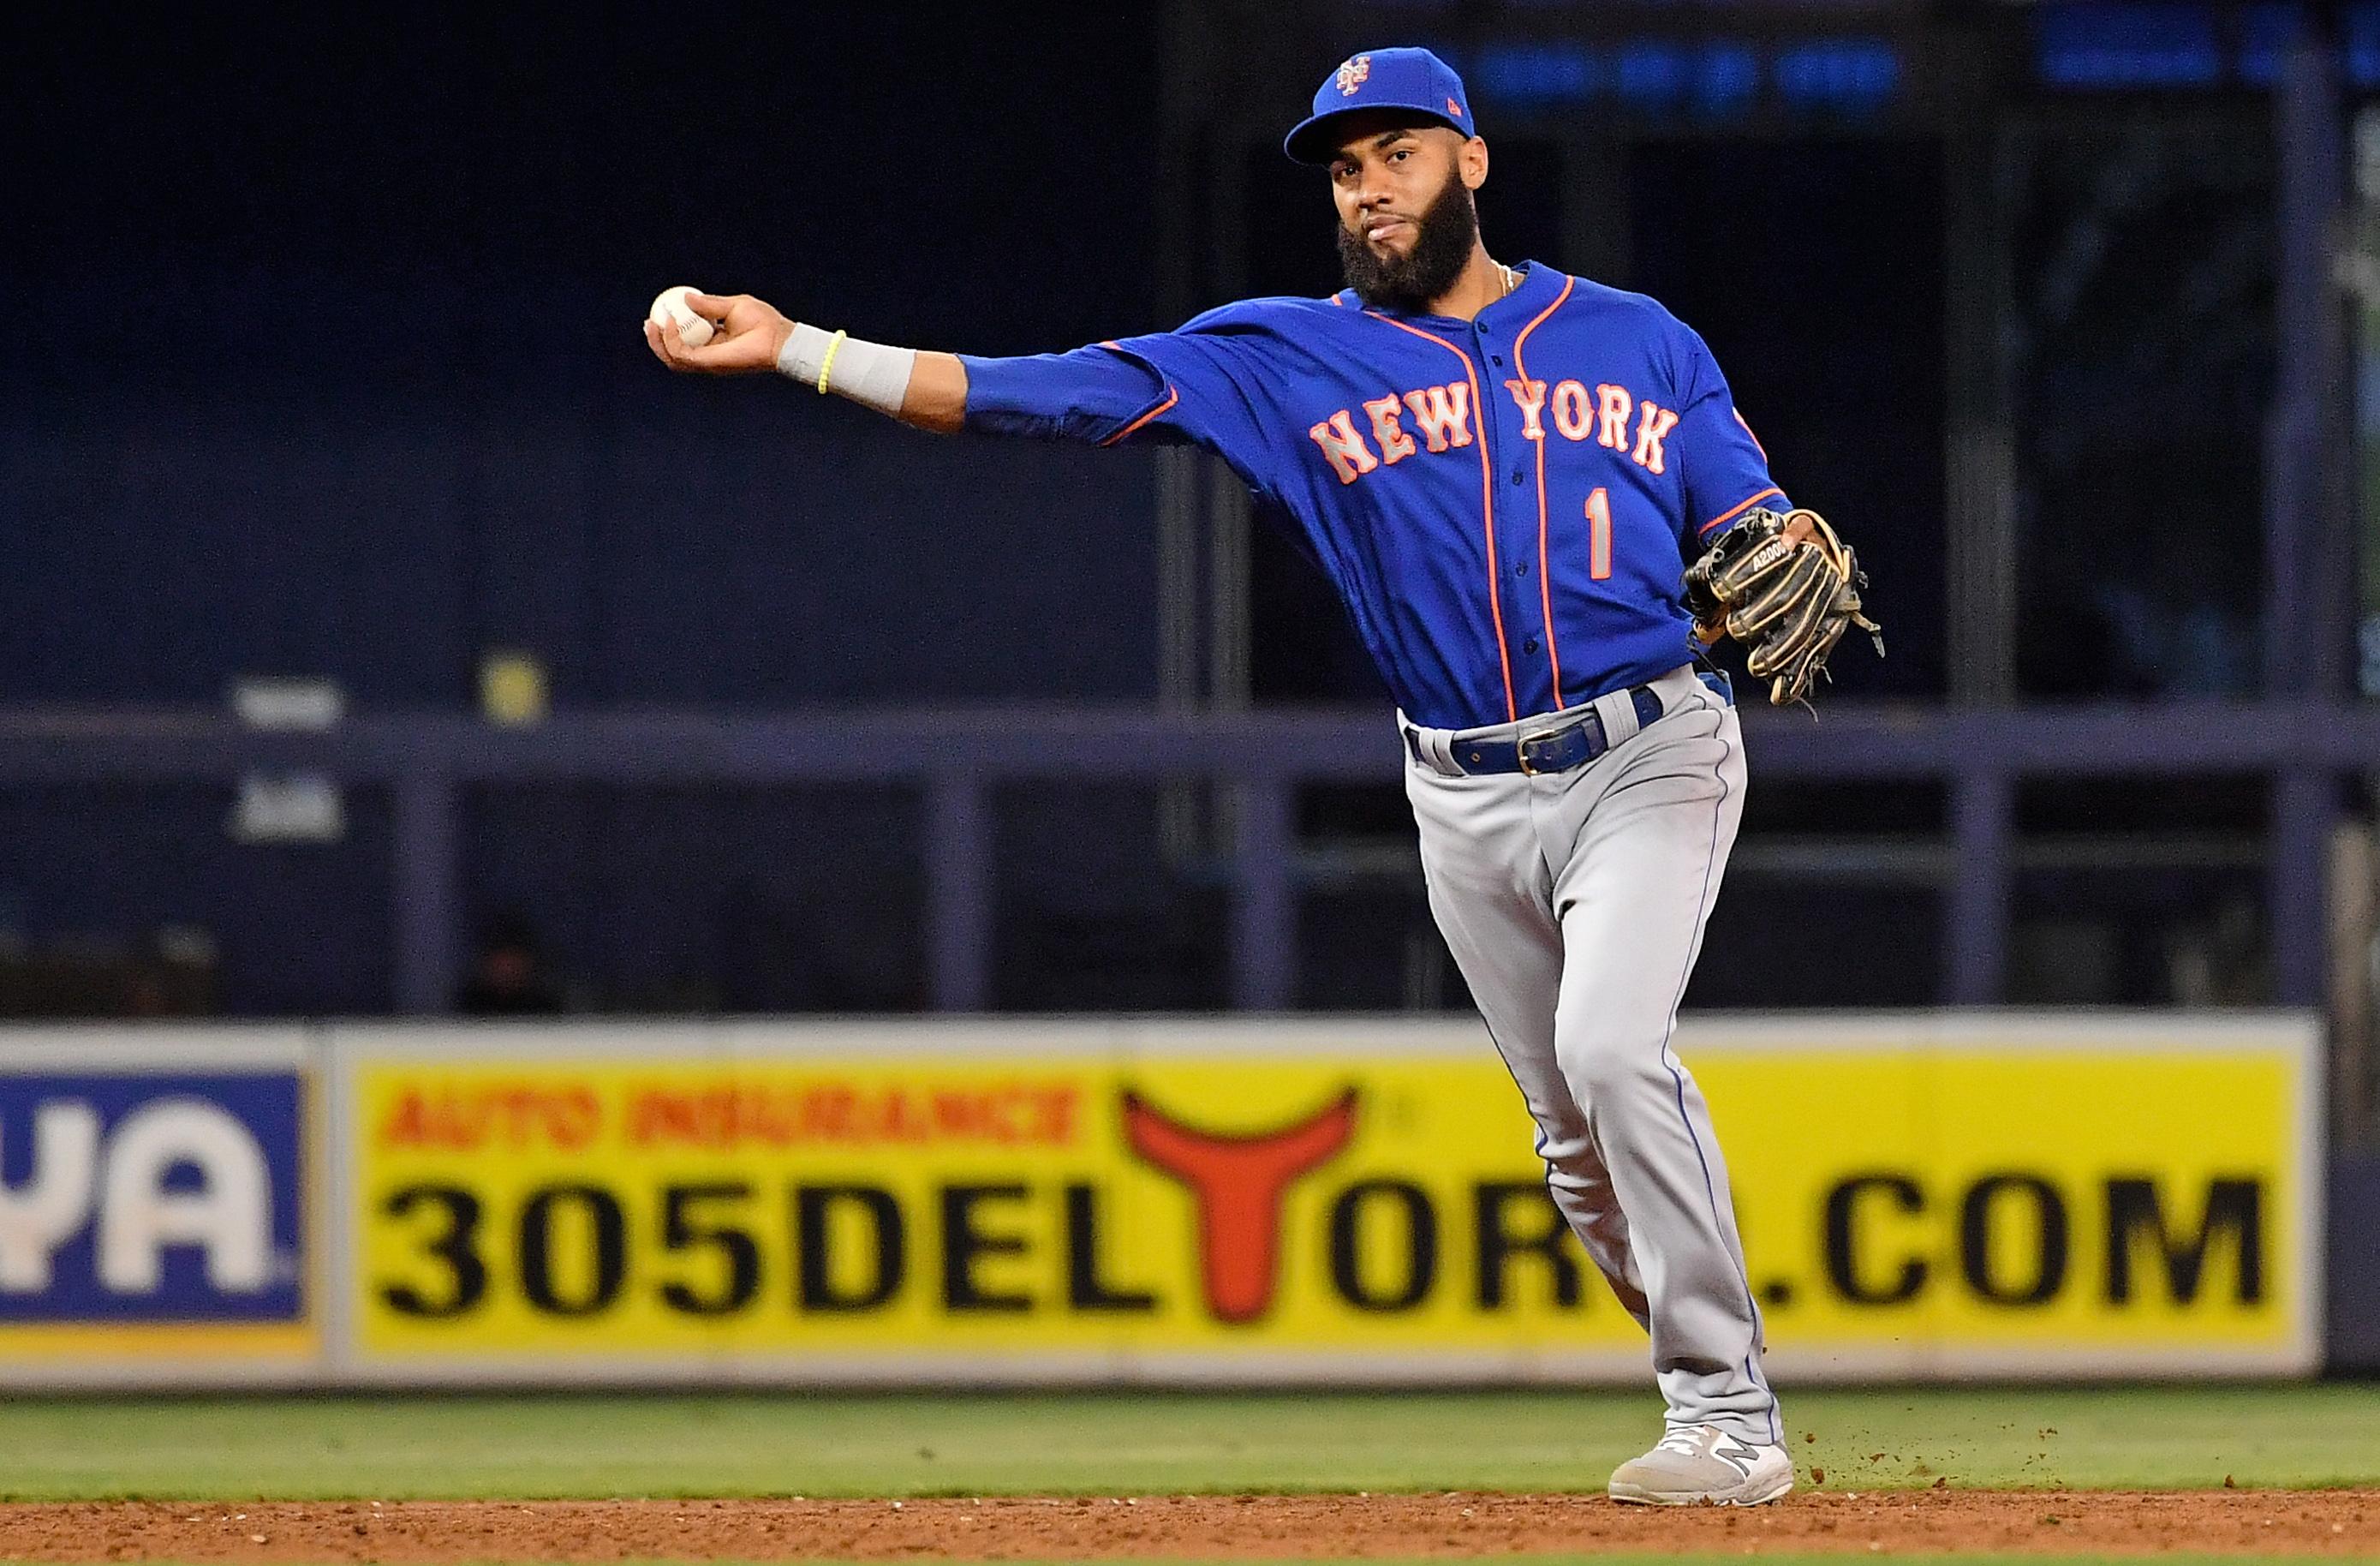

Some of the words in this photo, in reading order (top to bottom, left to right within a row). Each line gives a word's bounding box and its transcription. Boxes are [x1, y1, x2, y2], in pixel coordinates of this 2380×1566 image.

[1309, 382, 1473, 485] NEW
[1505, 380, 1679, 475] YORK
[1584, 487, 1613, 580] 1
[383, 1085, 601, 1150] AUTO
[625, 1085, 1079, 1150] INSURANCE
